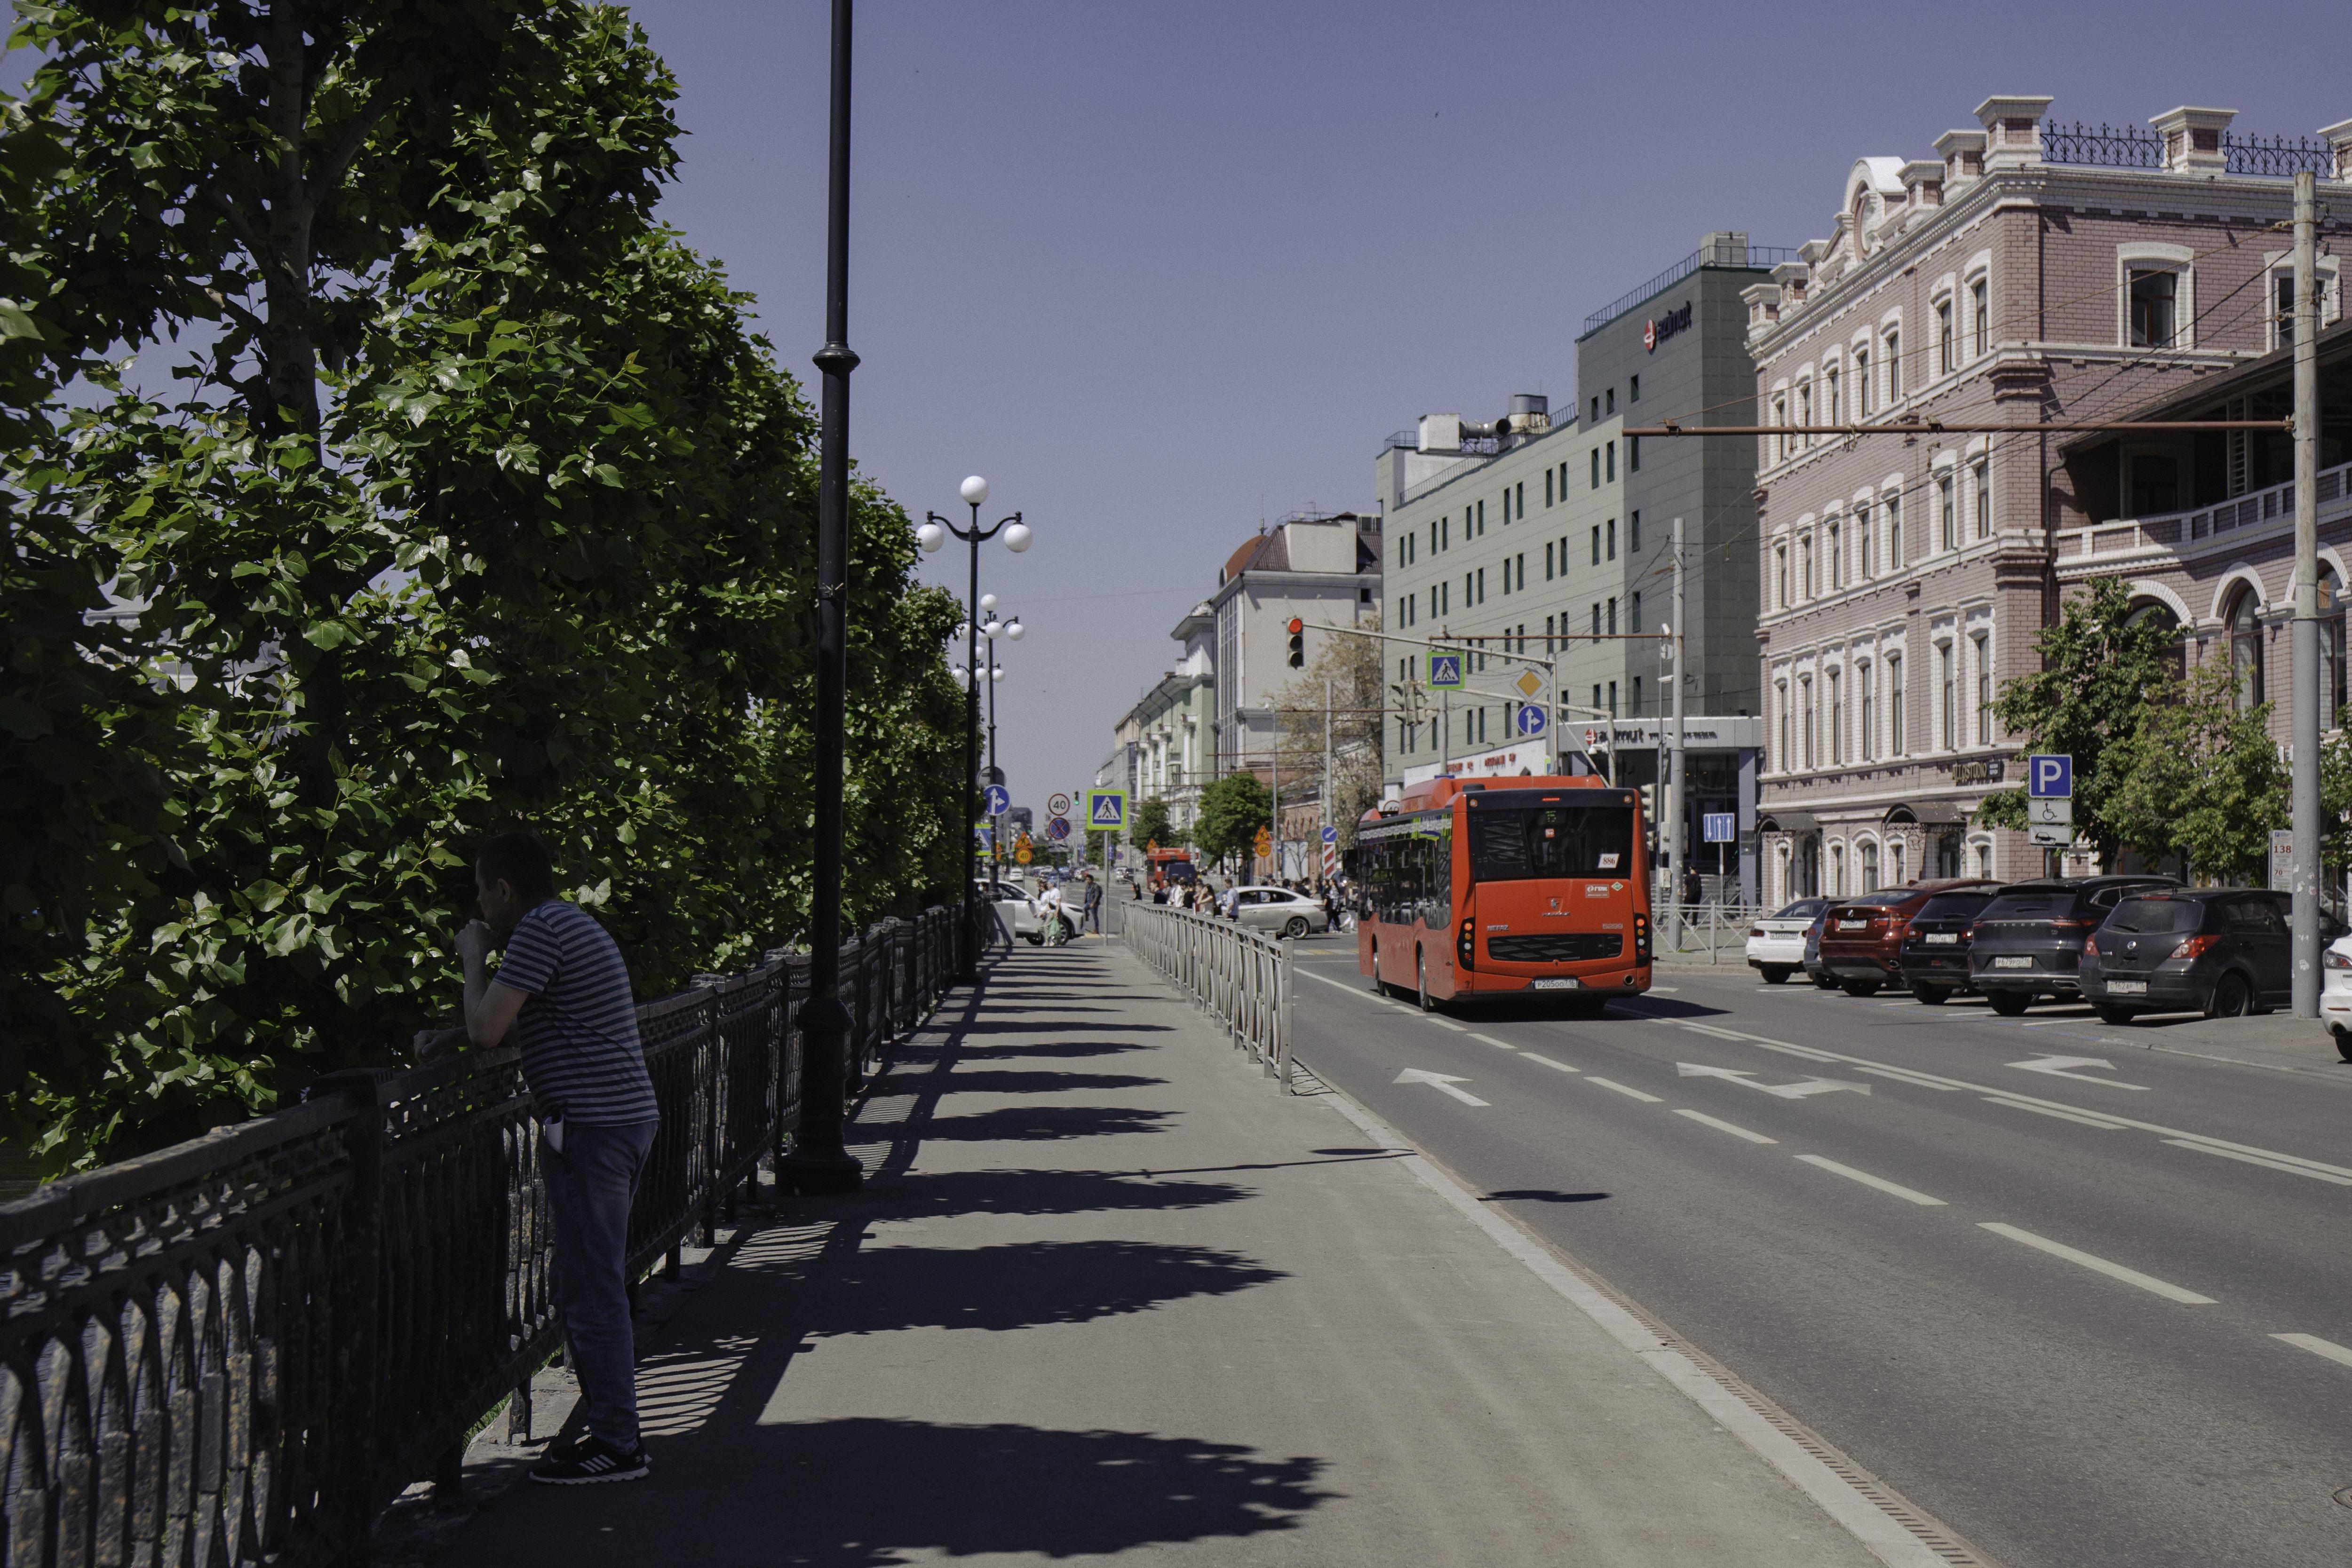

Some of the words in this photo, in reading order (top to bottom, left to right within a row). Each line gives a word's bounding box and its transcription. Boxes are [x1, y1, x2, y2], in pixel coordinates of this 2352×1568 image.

[2039, 760, 2062, 792] P
[1053, 800, 1066, 809] 40
[2273, 845, 2292, 854] 138
